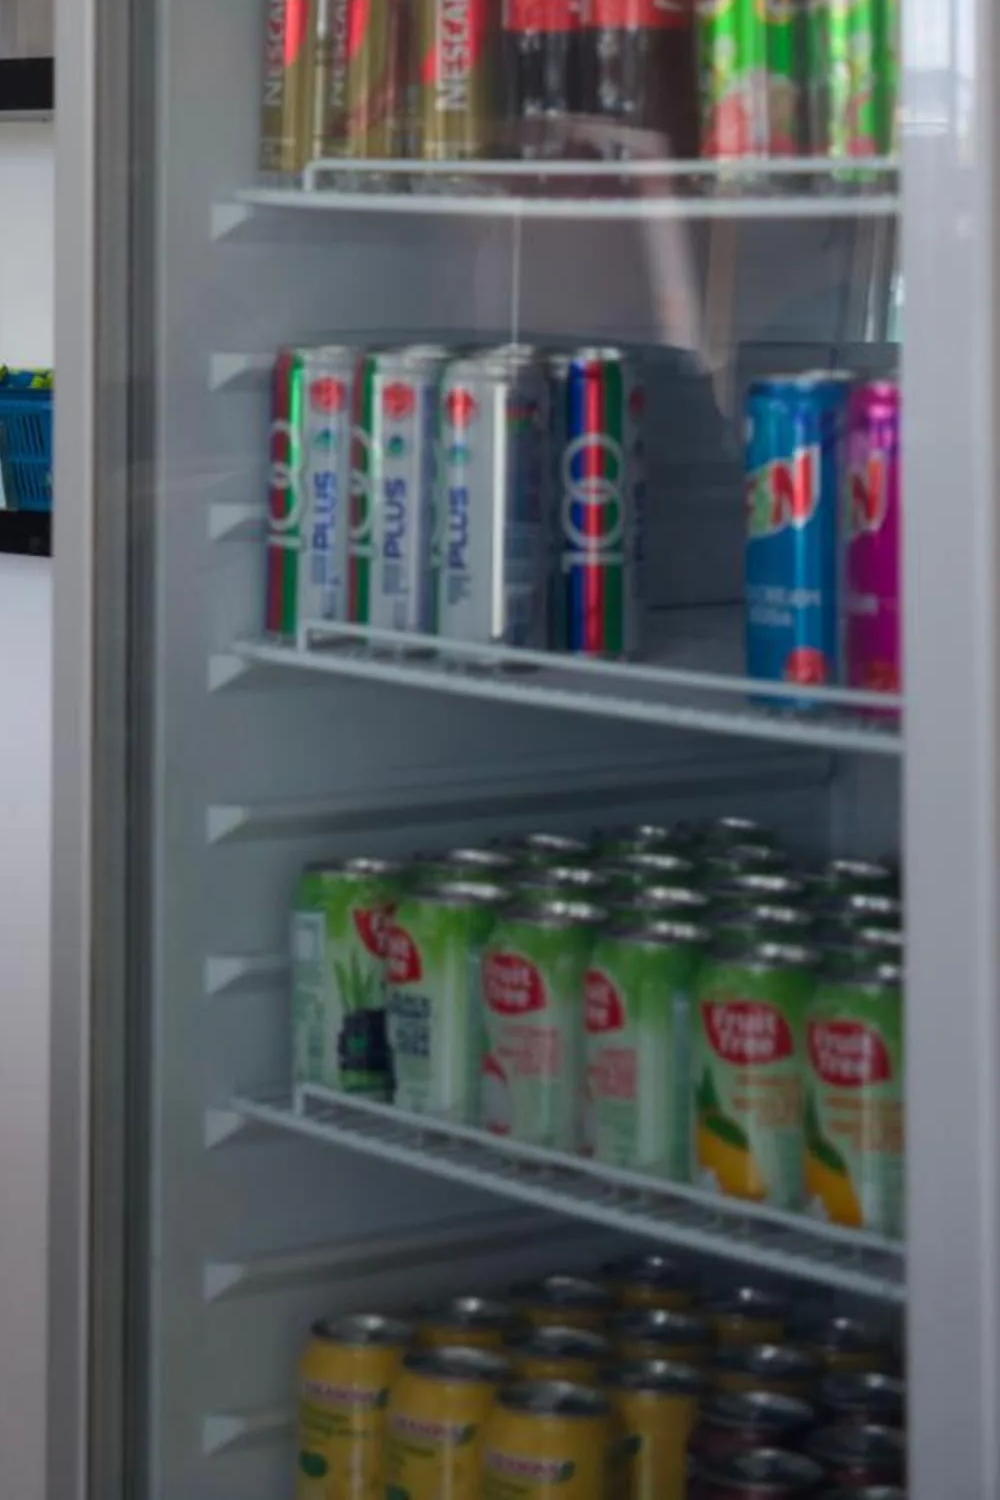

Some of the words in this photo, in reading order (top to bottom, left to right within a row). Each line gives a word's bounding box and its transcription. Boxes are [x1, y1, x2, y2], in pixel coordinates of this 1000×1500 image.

[312, 470, 338, 549] PLUS
[381, 477, 406, 559] PLUS
[448, 486, 471, 570] PLUS
[711, 1004, 777, 1037] Fruit
